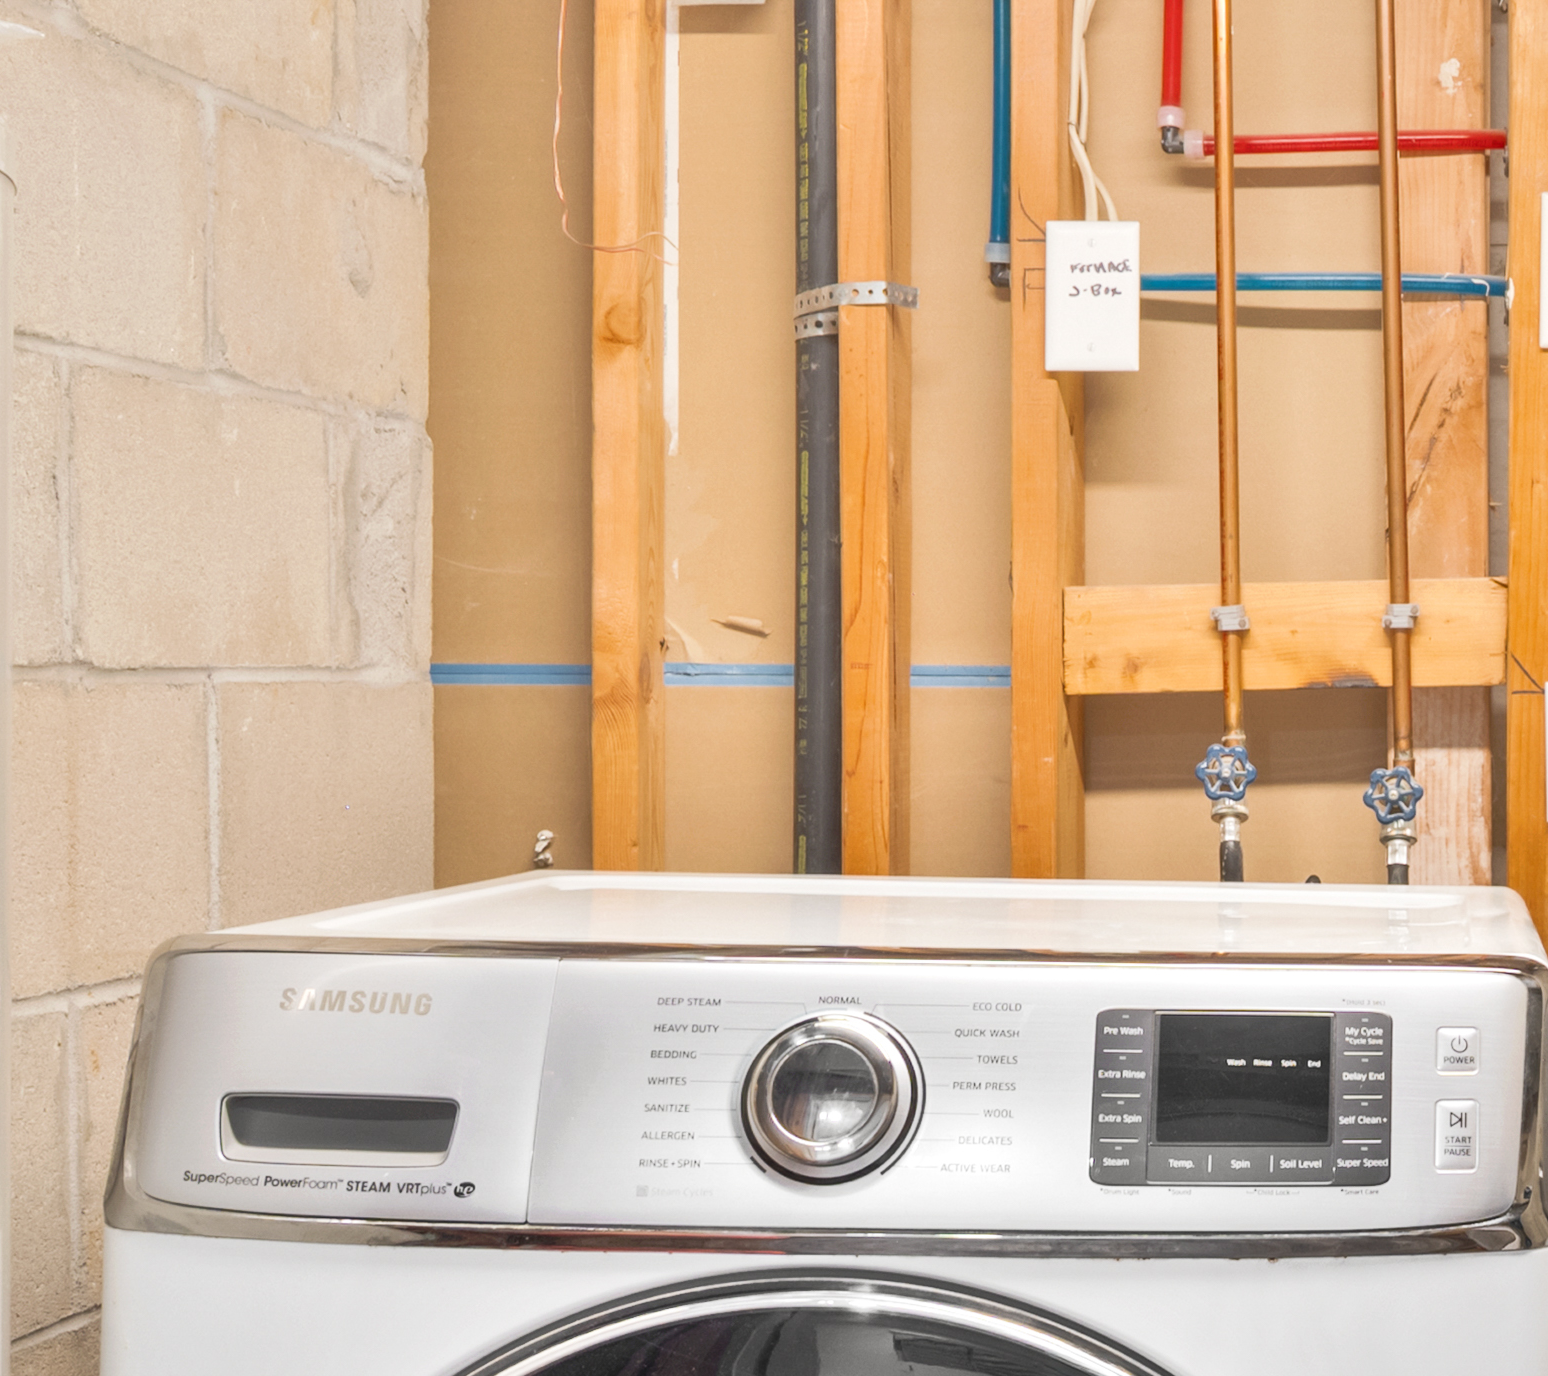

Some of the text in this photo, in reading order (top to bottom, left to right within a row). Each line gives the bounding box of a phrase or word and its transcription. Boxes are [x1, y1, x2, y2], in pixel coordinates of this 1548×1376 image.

[279, 988, 432, 1016] SAMSUNG
[687, 998, 721, 1006] STEAM
[818, 996, 862, 1005] NORMAL
[973, 1003, 1022, 1011] ECO COLD
[654, 1024, 719, 1033] HEAVY DUTY
[1104, 1027, 1143, 1035] Pre Wash
[1345, 1027, 1383, 1036] My Cycle
[955, 1029, 1020, 1038] QUICK WASH
[651, 1050, 697, 1059] BEDDING
[977, 1055, 1018, 1064] TOWELS
[1443, 1056, 1475, 1064] POWER
[1098, 1070, 1146, 1079] Extra Rinse
[1342, 1072, 1384, 1082] Delay End
[648, 1077, 687, 1086] WHITES
[953, 1082, 1016, 1091] PERM PRESS
[644, 1104, 690, 1113] SANITIZE
[983, 1109, 1014, 1118] WOOL
[1099, 1114, 1142, 1124] Extra Spin
[1339, 1116, 1355, 1124] Self
[641, 1131, 695, 1140] ALLERGEN
[1444, 1136, 1472, 1144] START
[958, 1136, 1013, 1145] DELICATES
[1444, 1148, 1471, 1156] PAUSE
[639, 1159, 669, 1168] RINSE
[677, 1159, 701, 1168] SPIN
[1103, 1158, 1130, 1166] Steam
[1231, 1159, 1250, 1170] Spin
[1280, 1159, 1322, 1169] Soil Level
[1337, 1158, 1389, 1168] Super Speed
[940, 1164, 1010, 1173] ACTIVE WEAR
[183, 1171, 259, 1187] SuperSpeed
[346, 1181, 391, 1194] STEAM
